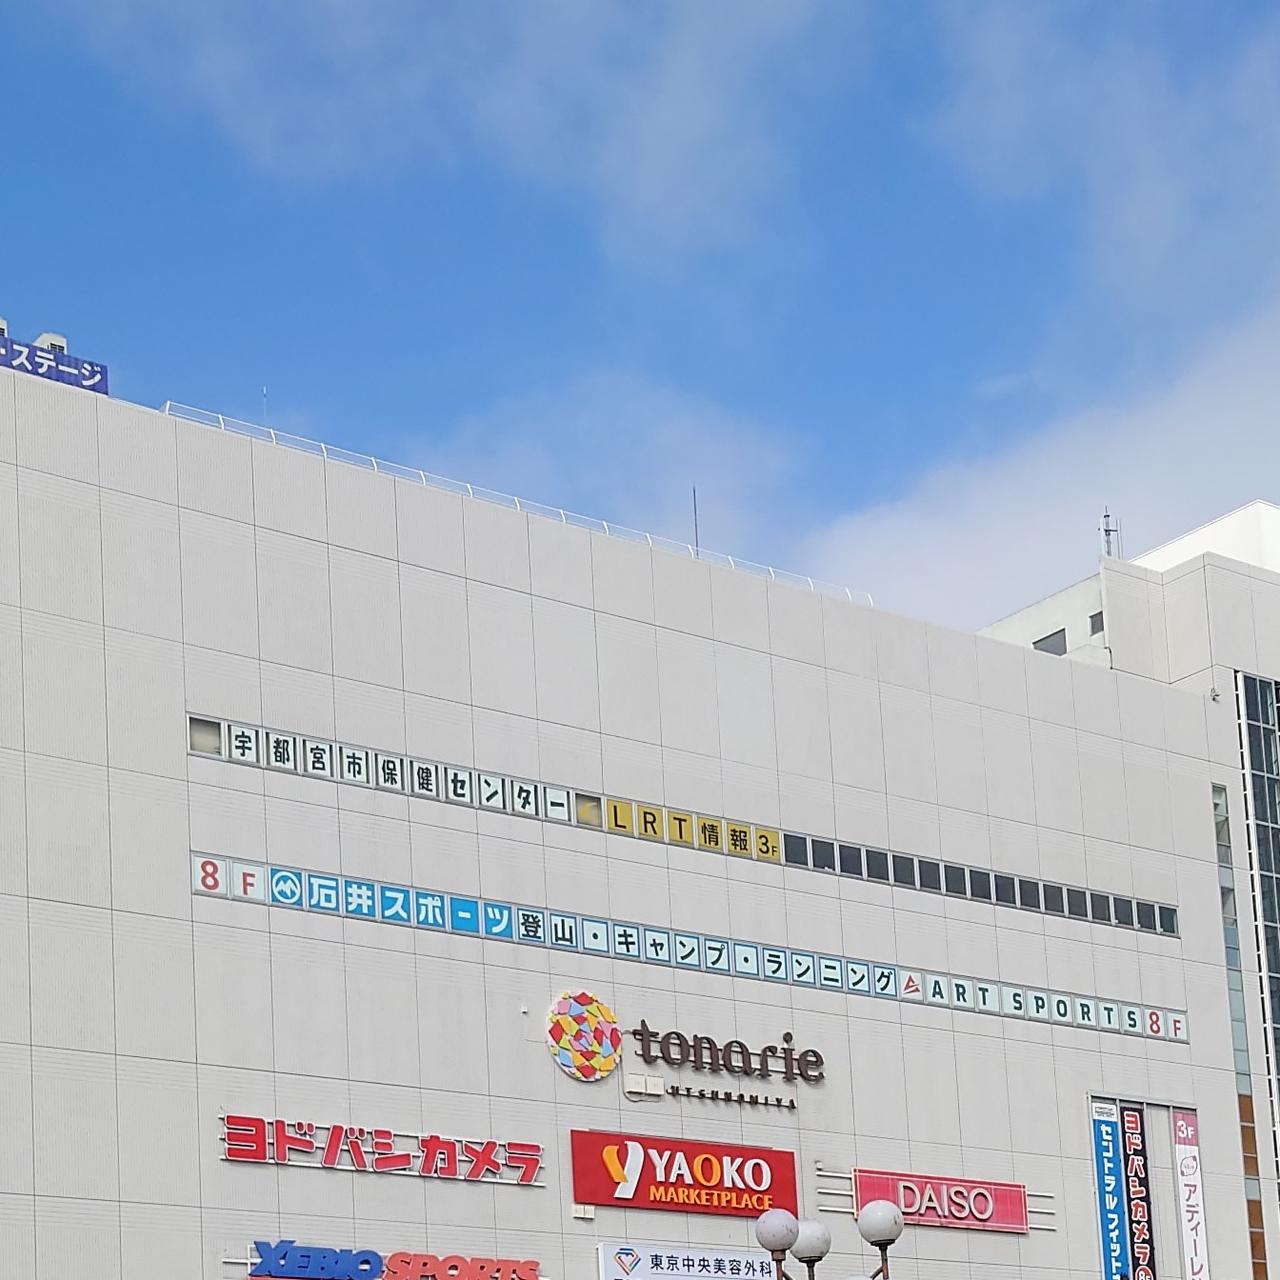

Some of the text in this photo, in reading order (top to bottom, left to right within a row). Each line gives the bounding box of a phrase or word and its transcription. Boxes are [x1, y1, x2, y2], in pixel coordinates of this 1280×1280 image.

[233, 730, 566, 810] 宇都宮市保健センター
[308, 879, 510, 935] 石井スポーツ
[931, 979, 990, 1007] ART
[1012, 991, 1138, 1030] SPORTS
[632, 1019, 825, 1082] tonarie
[669, 1085, 797, 1110] UTSUNOMIYA
[223, 1113, 545, 1187] ヨドバシカメラ
[1176, 1120, 1195, 1139] 3F
[646, 1148, 773, 1191] YAOKO
[1123, 1111, 1150, 1266] ヨドバシカメラ
[649, 1185, 774, 1212] MARKETPLACE
[898, 1180, 994, 1221] DAISO
[650, 1252, 773, 1280] 東京中央美容外科
